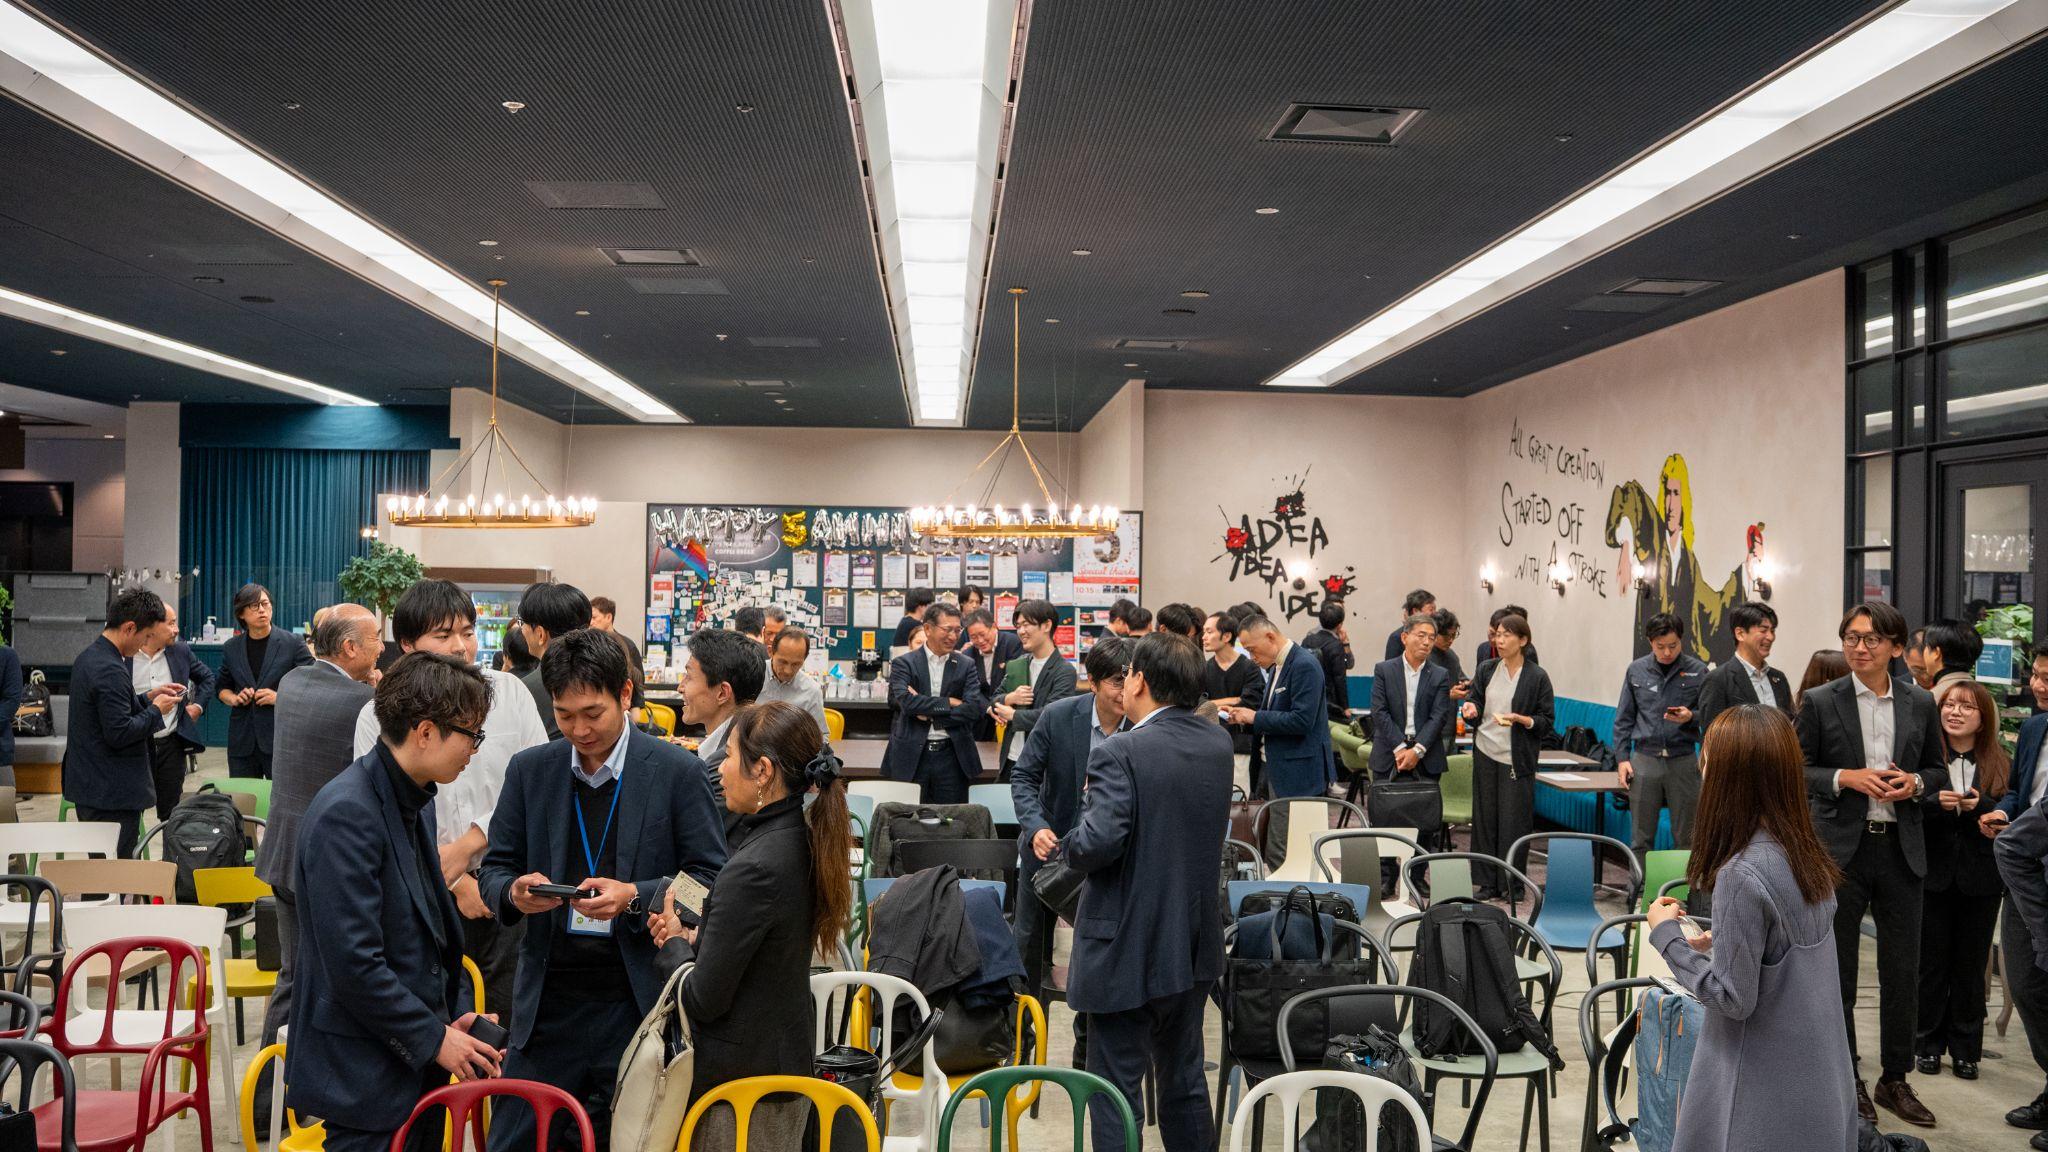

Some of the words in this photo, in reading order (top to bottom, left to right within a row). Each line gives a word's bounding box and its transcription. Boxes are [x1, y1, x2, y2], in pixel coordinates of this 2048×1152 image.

[1529, 435, 1553, 474] GREAT
[1557, 446, 1605, 489] CREATION
[651, 507, 778, 549] HAPPY
[782, 511, 807, 548] 5
[1499, 481, 1552, 547] STARTED
[1558, 502, 1584, 545] OFF
[1567, 552, 1607, 599] STROKE
